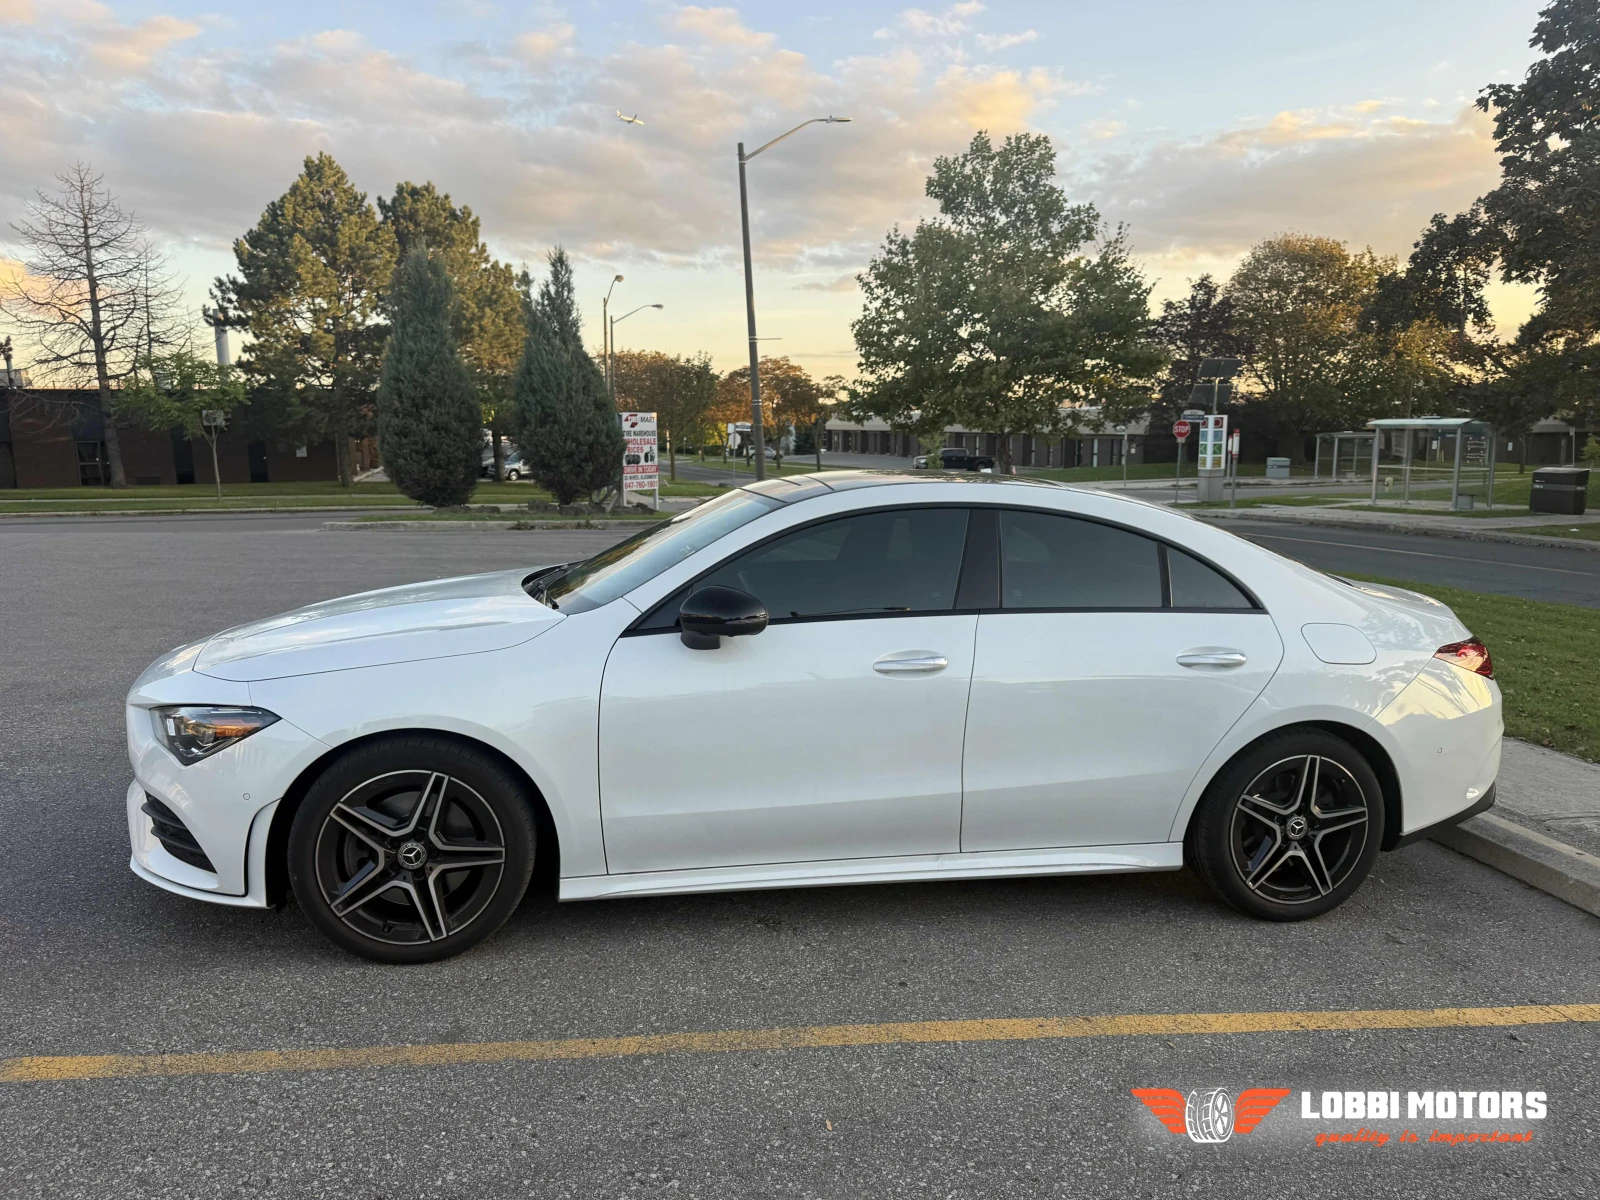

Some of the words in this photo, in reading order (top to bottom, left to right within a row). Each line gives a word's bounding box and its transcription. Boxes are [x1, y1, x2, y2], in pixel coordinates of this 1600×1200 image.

[1174, 425, 1189, 433] STOP
[624, 466, 638, 474] DRIVE
[643, 465, 658, 473] TODAY
